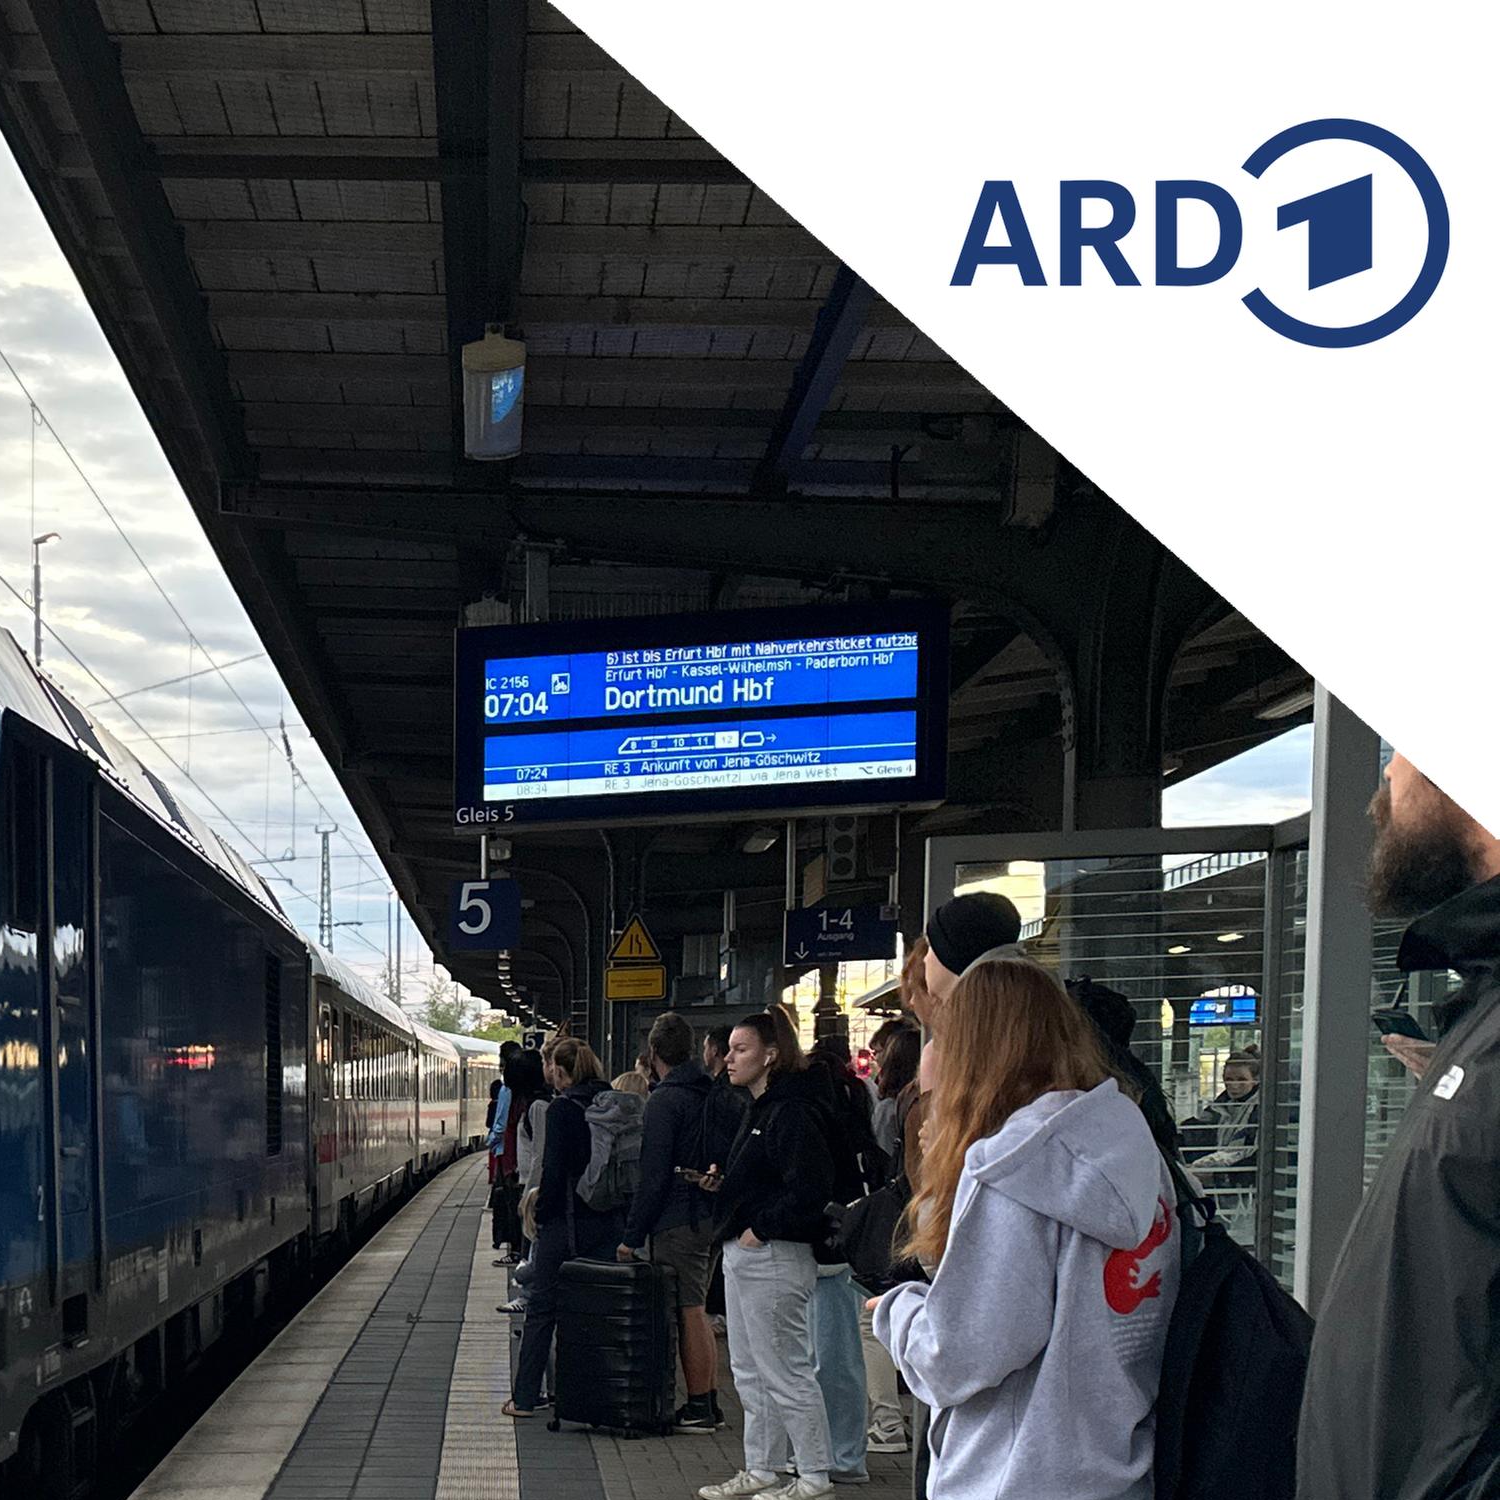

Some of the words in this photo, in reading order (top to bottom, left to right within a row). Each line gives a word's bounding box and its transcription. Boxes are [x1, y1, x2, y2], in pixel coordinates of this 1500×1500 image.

[643, 650, 661, 663] bis
[665, 647, 702, 661] Erfurt
[706, 645, 728, 659] Hbf
[731, 644, 751, 657] mit
[755, 637, 871, 655] Nahverkehrsticket
[605, 668, 642, 682] Erfurt
[646, 666, 668, 680] Hbf
[682, 658, 792, 678] Kassel-Wilhelmsh
[806, 655, 869, 669] Paderborn
[872, 652, 894, 666] Hbf
[485, 678, 497, 690] IC
[500, 676, 529, 689] 2156
[605, 680, 723, 710] Dortmund
[733, 677, 774, 701] Hbf
[484, 691, 549, 718] 07:04
[516, 768, 548, 781] 07:24
[604, 762, 619, 775] RE
[623, 763, 631, 774] 3
[641, 758, 691, 773] Ankunft
[695, 759, 717, 769] von
[722, 751, 820, 769] Jena-Göschwitz
[516, 784, 548, 796] 08:34
[604, 778, 618, 790] RE
[623, 778, 630, 789] 3
[750, 771, 768, 782] via
[772, 768, 800, 780] Jena
[805, 766, 838, 778] West
[456, 806, 499, 824] Gleis
[504, 805, 514, 822] 5
[458, 881, 492, 935] 5
[818, 908, 853, 931] 1-4
[525, 1033, 536, 1050] 5
